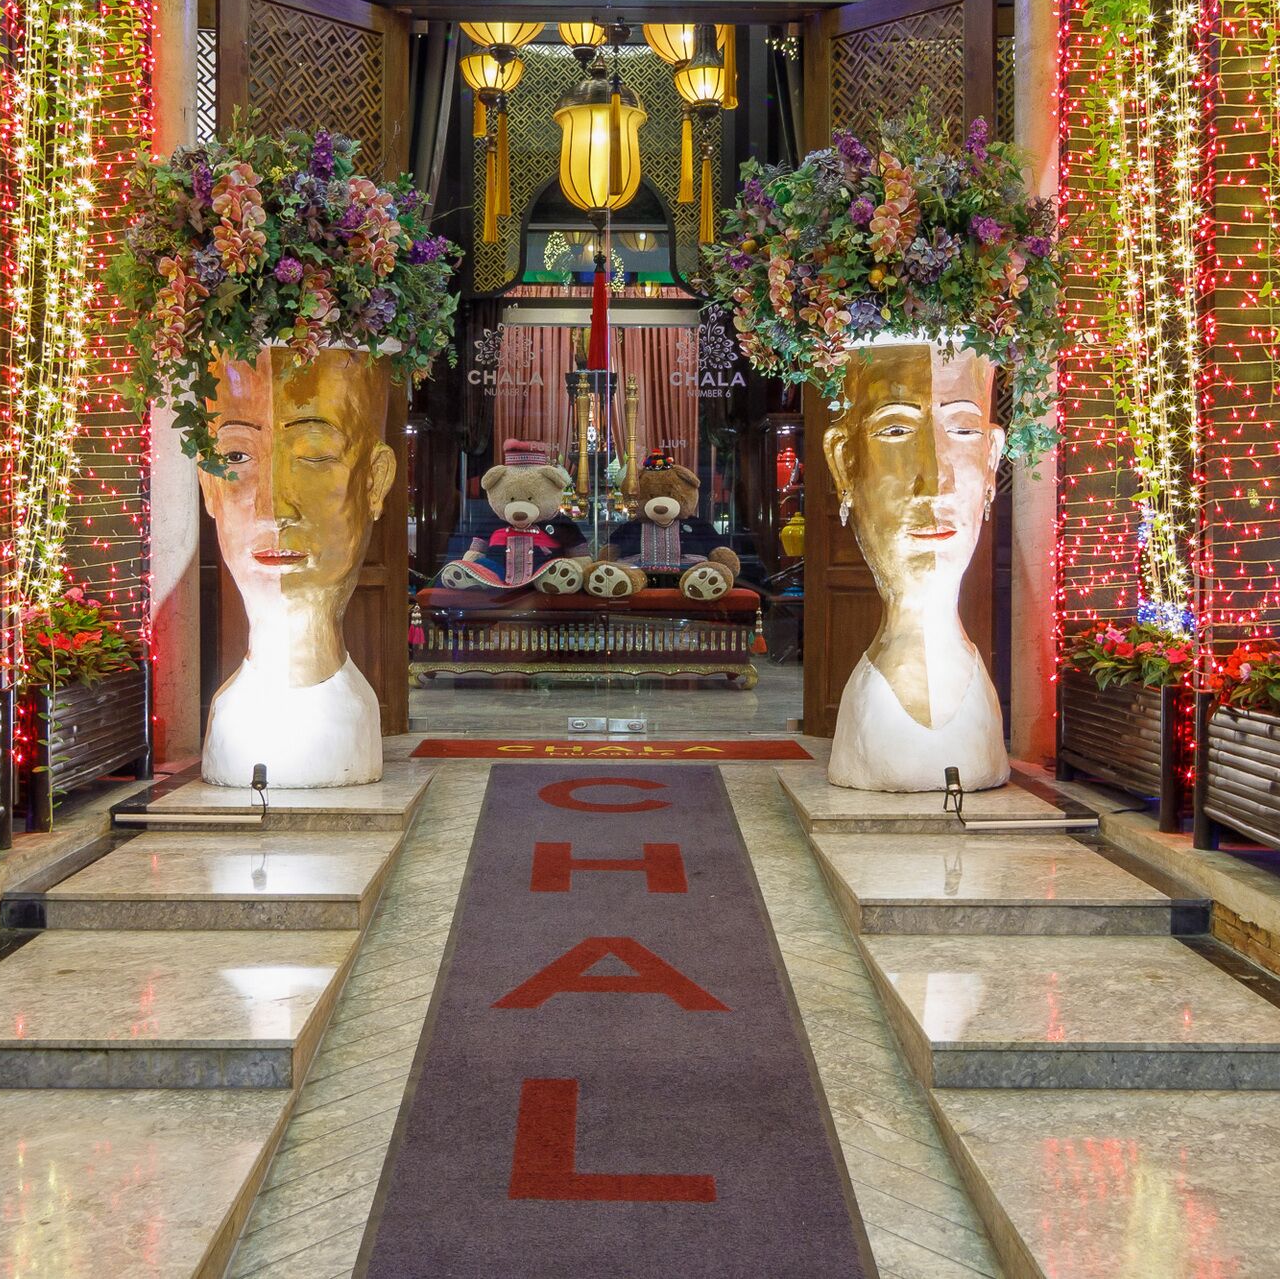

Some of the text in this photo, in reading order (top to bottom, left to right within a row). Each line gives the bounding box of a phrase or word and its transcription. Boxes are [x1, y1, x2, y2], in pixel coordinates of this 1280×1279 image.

[467, 370, 544, 386] CHALA
[670, 371, 747, 387] CHALA
[484, 388, 529, 397] NUMBER 6
[687, 389, 732, 398] NUMBER 6
[530, 443, 560, 452] PUSH
